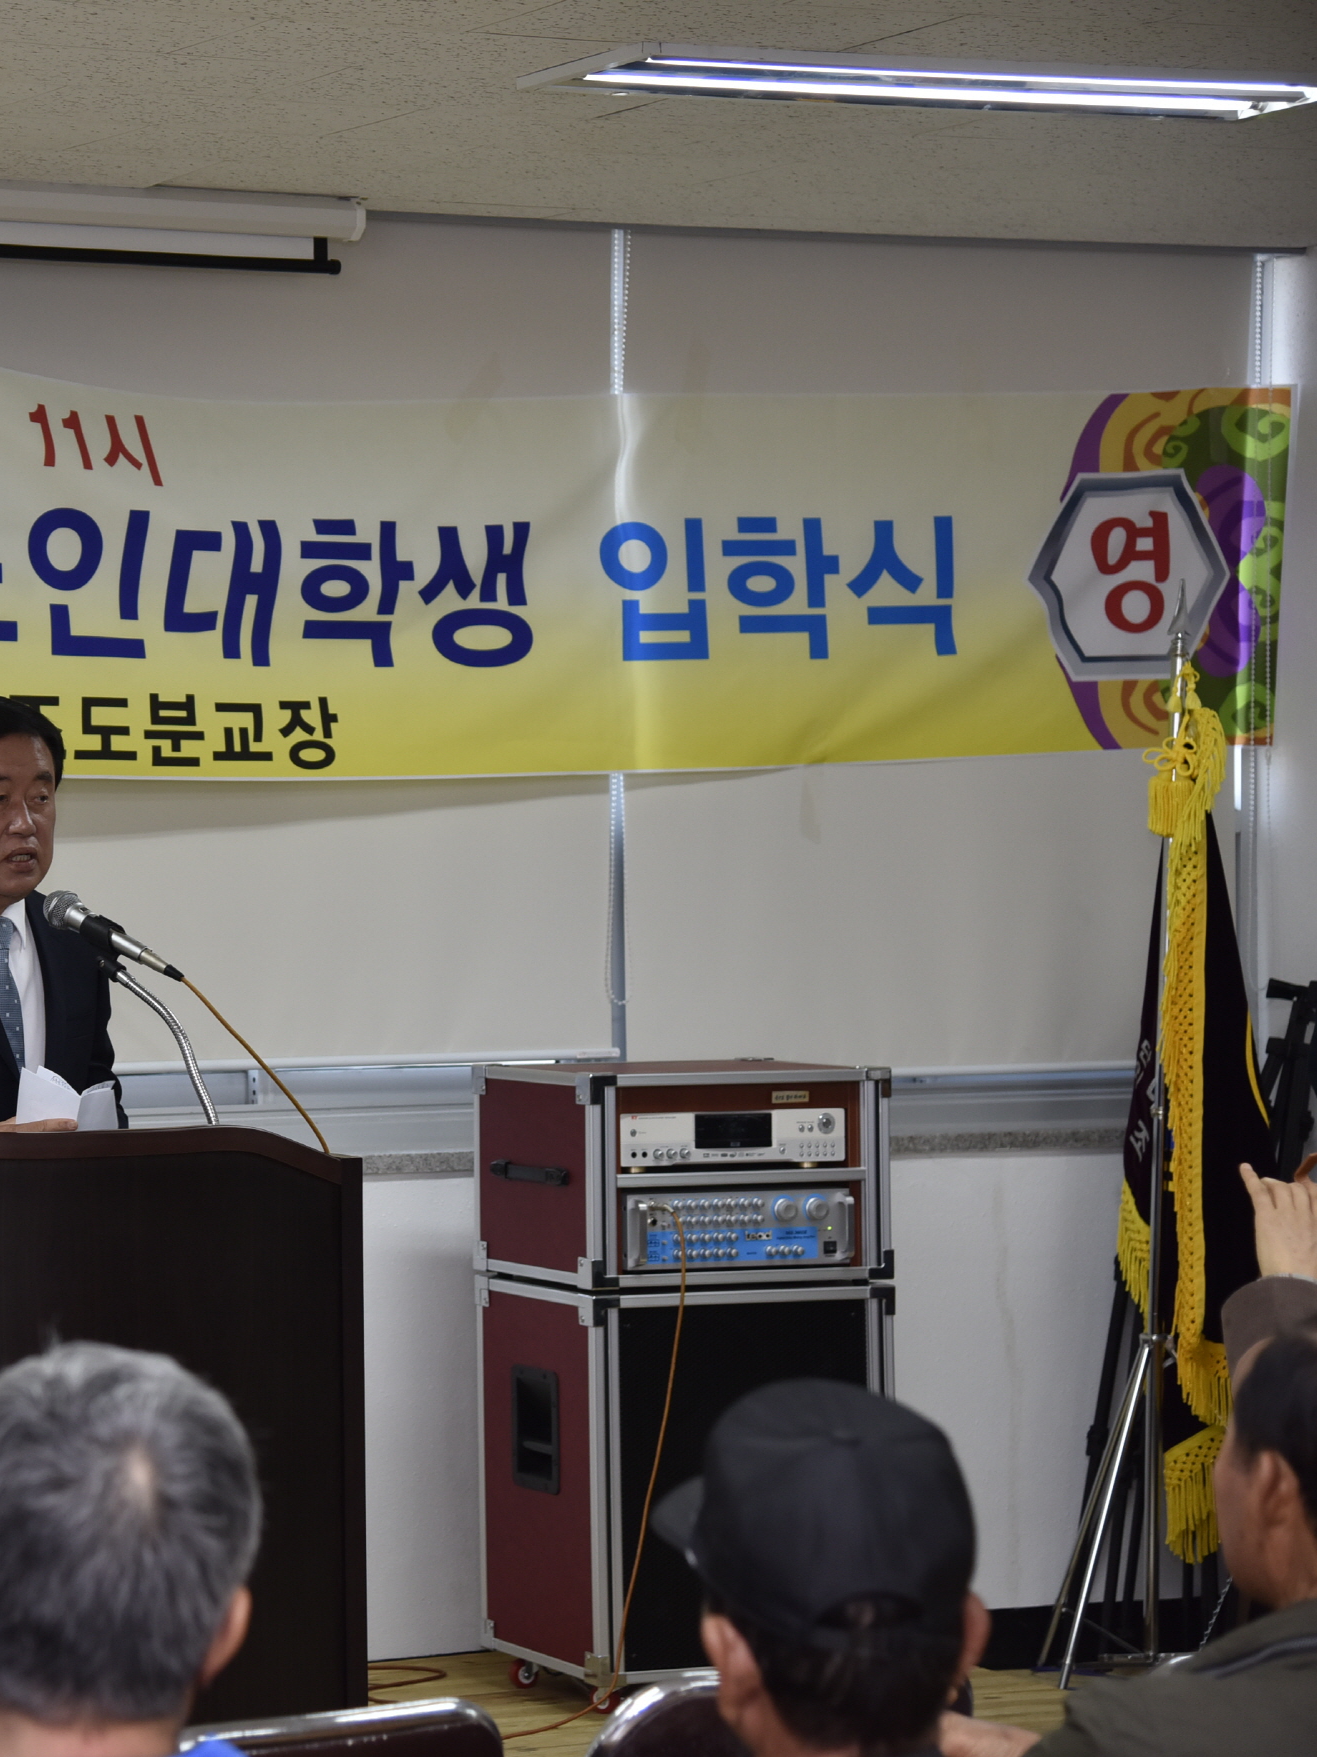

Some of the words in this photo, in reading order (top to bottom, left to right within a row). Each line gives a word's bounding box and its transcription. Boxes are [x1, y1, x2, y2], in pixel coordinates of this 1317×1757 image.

[29, 403, 164, 487] 11시
[599, 516, 957, 662] 입학식
[1091, 510, 1171, 633] 영
